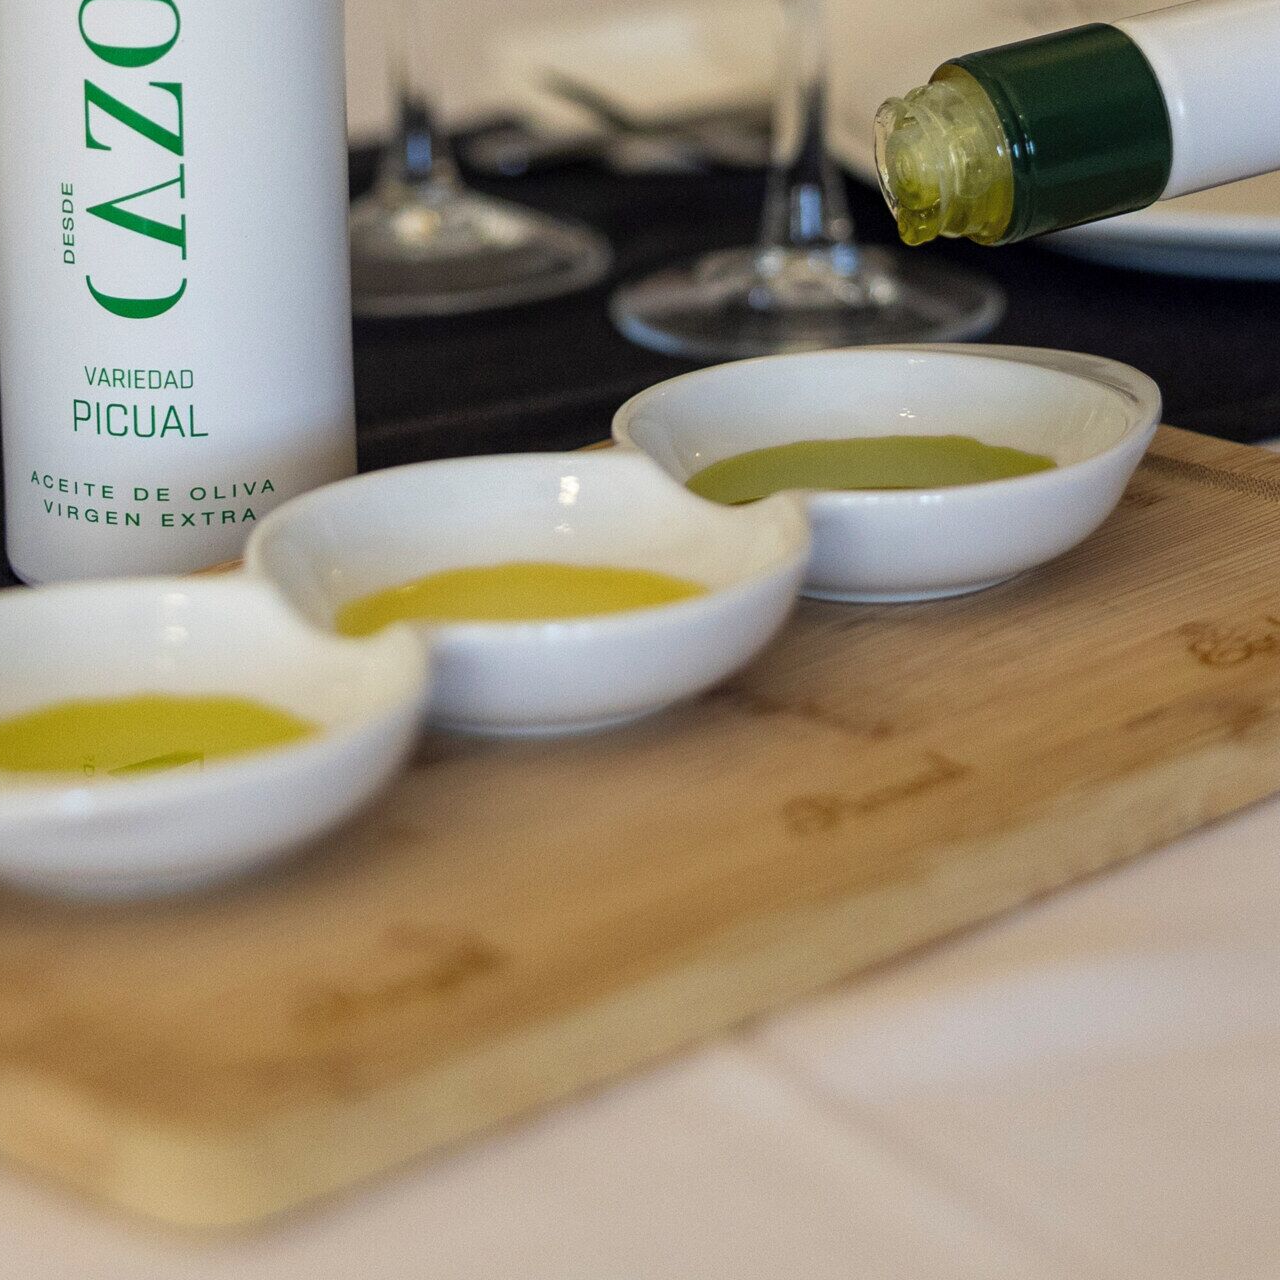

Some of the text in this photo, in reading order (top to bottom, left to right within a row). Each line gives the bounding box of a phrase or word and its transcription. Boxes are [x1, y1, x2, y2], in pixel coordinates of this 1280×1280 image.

[60, 181, 77, 266] DESDE
[84, 365, 194, 390] VARIEDAD
[72, 399, 210, 438] PICUAL
[30, 470, 275, 502] ACEITE DE OLIVA
[43, 498, 258, 528] VIRGEN EXTRA
